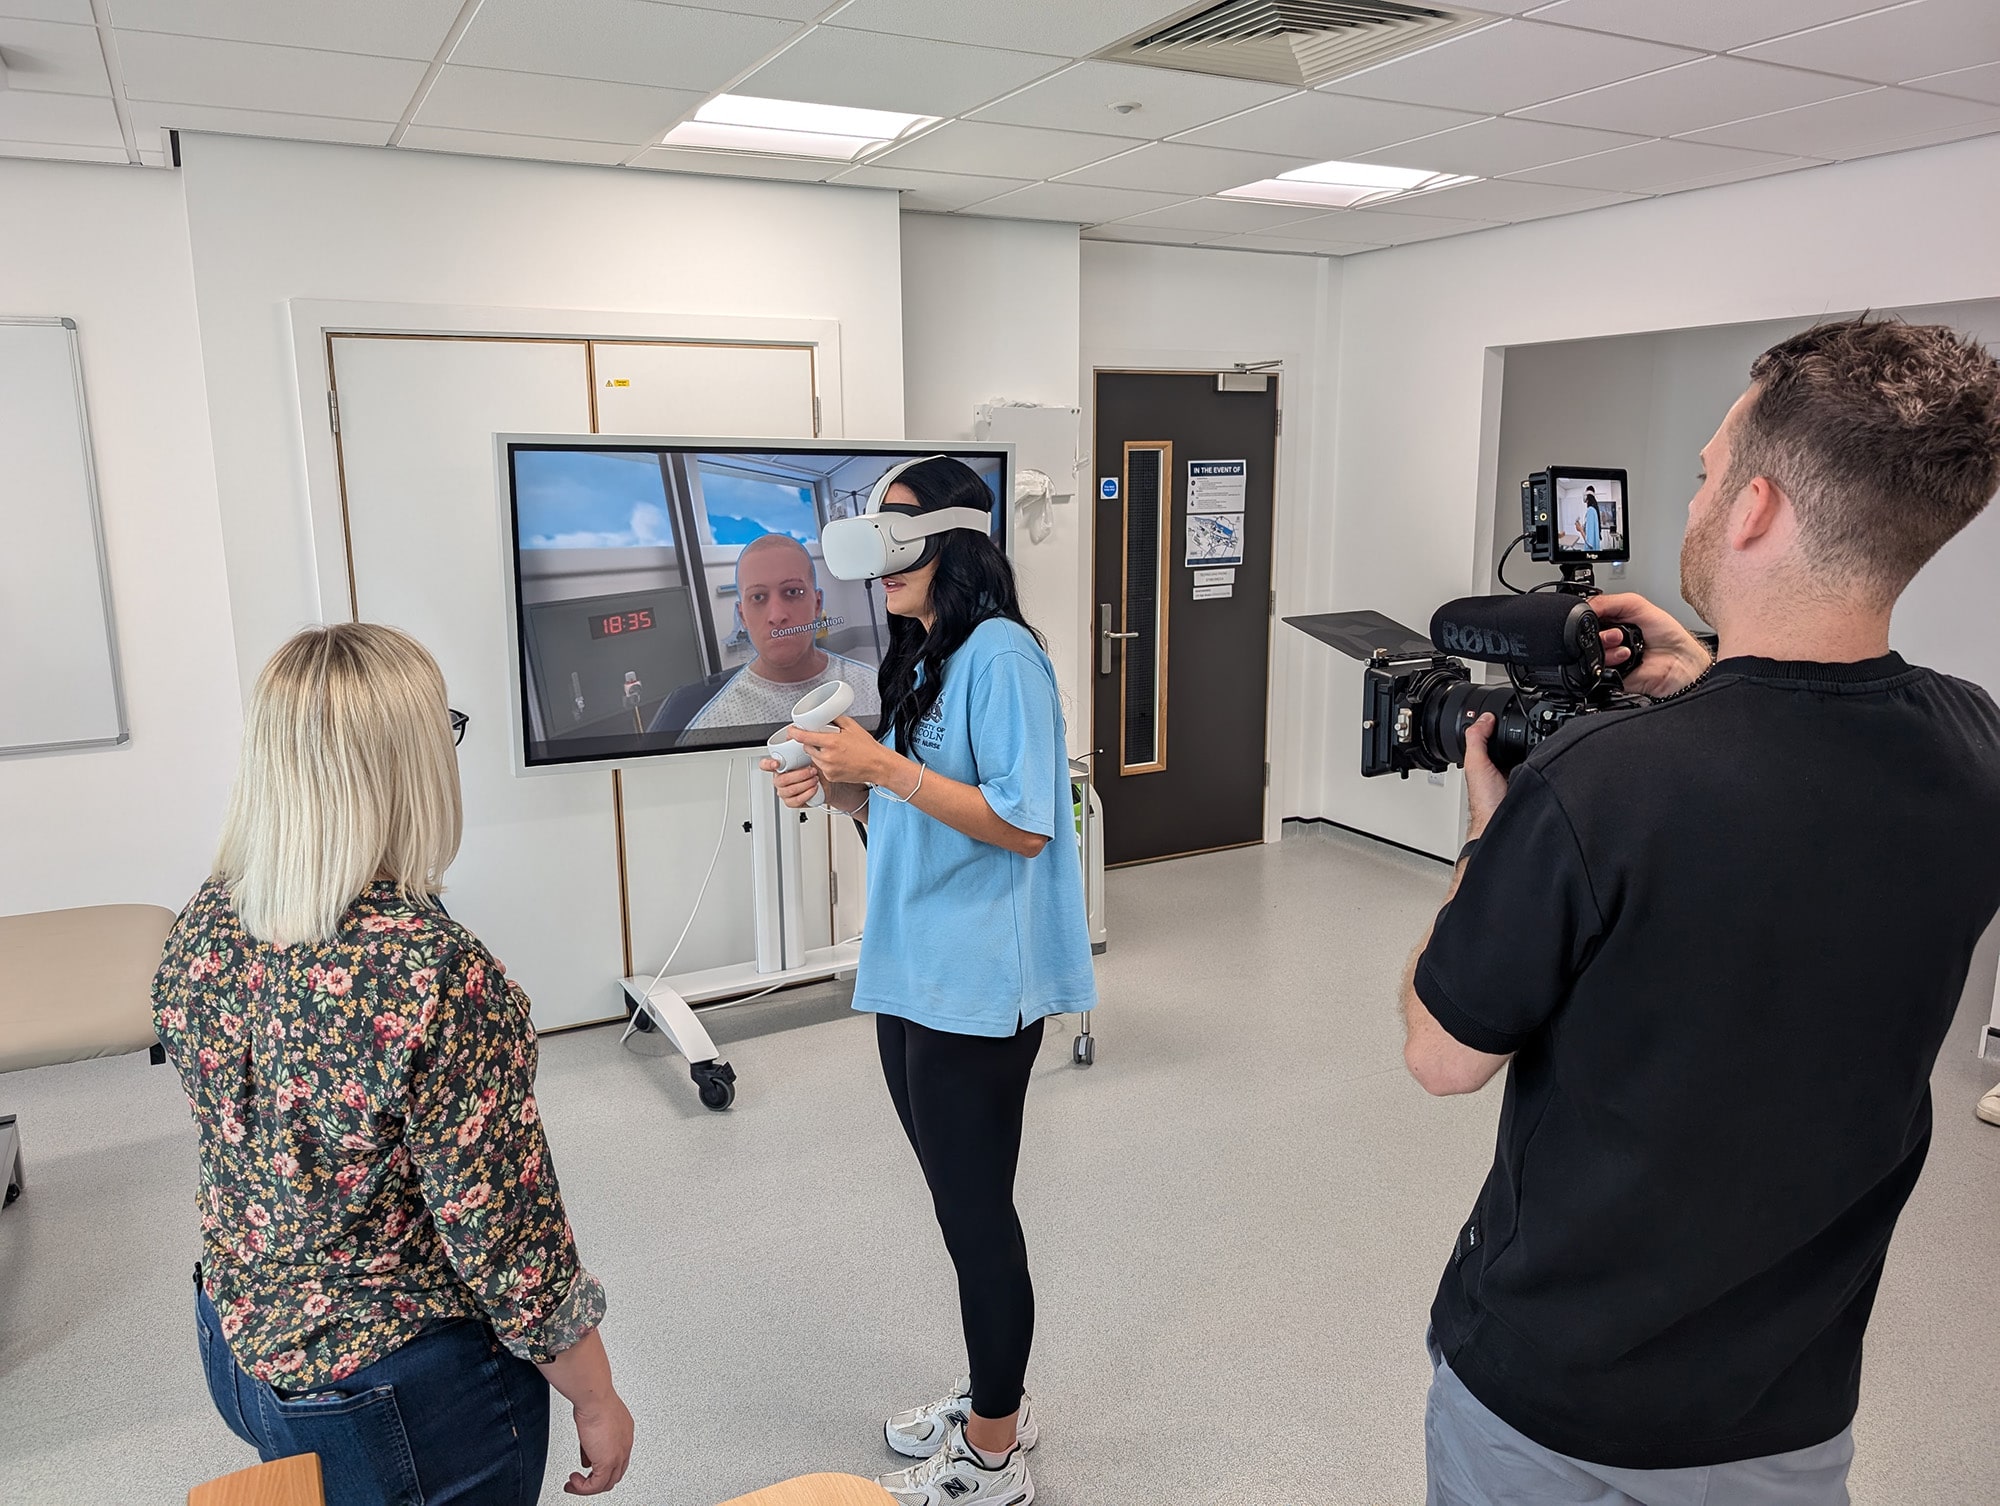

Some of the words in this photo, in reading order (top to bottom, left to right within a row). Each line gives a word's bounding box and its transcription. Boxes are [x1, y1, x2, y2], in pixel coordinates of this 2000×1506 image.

[1193, 466, 1200, 474] IN
[1201, 466, 1213, 474] THE
[1213, 466, 1232, 474] EVENT
[602, 611, 652, 635] 18:35
[770, 615, 845, 639] Communication
[941, 1477, 969, 1499] N
